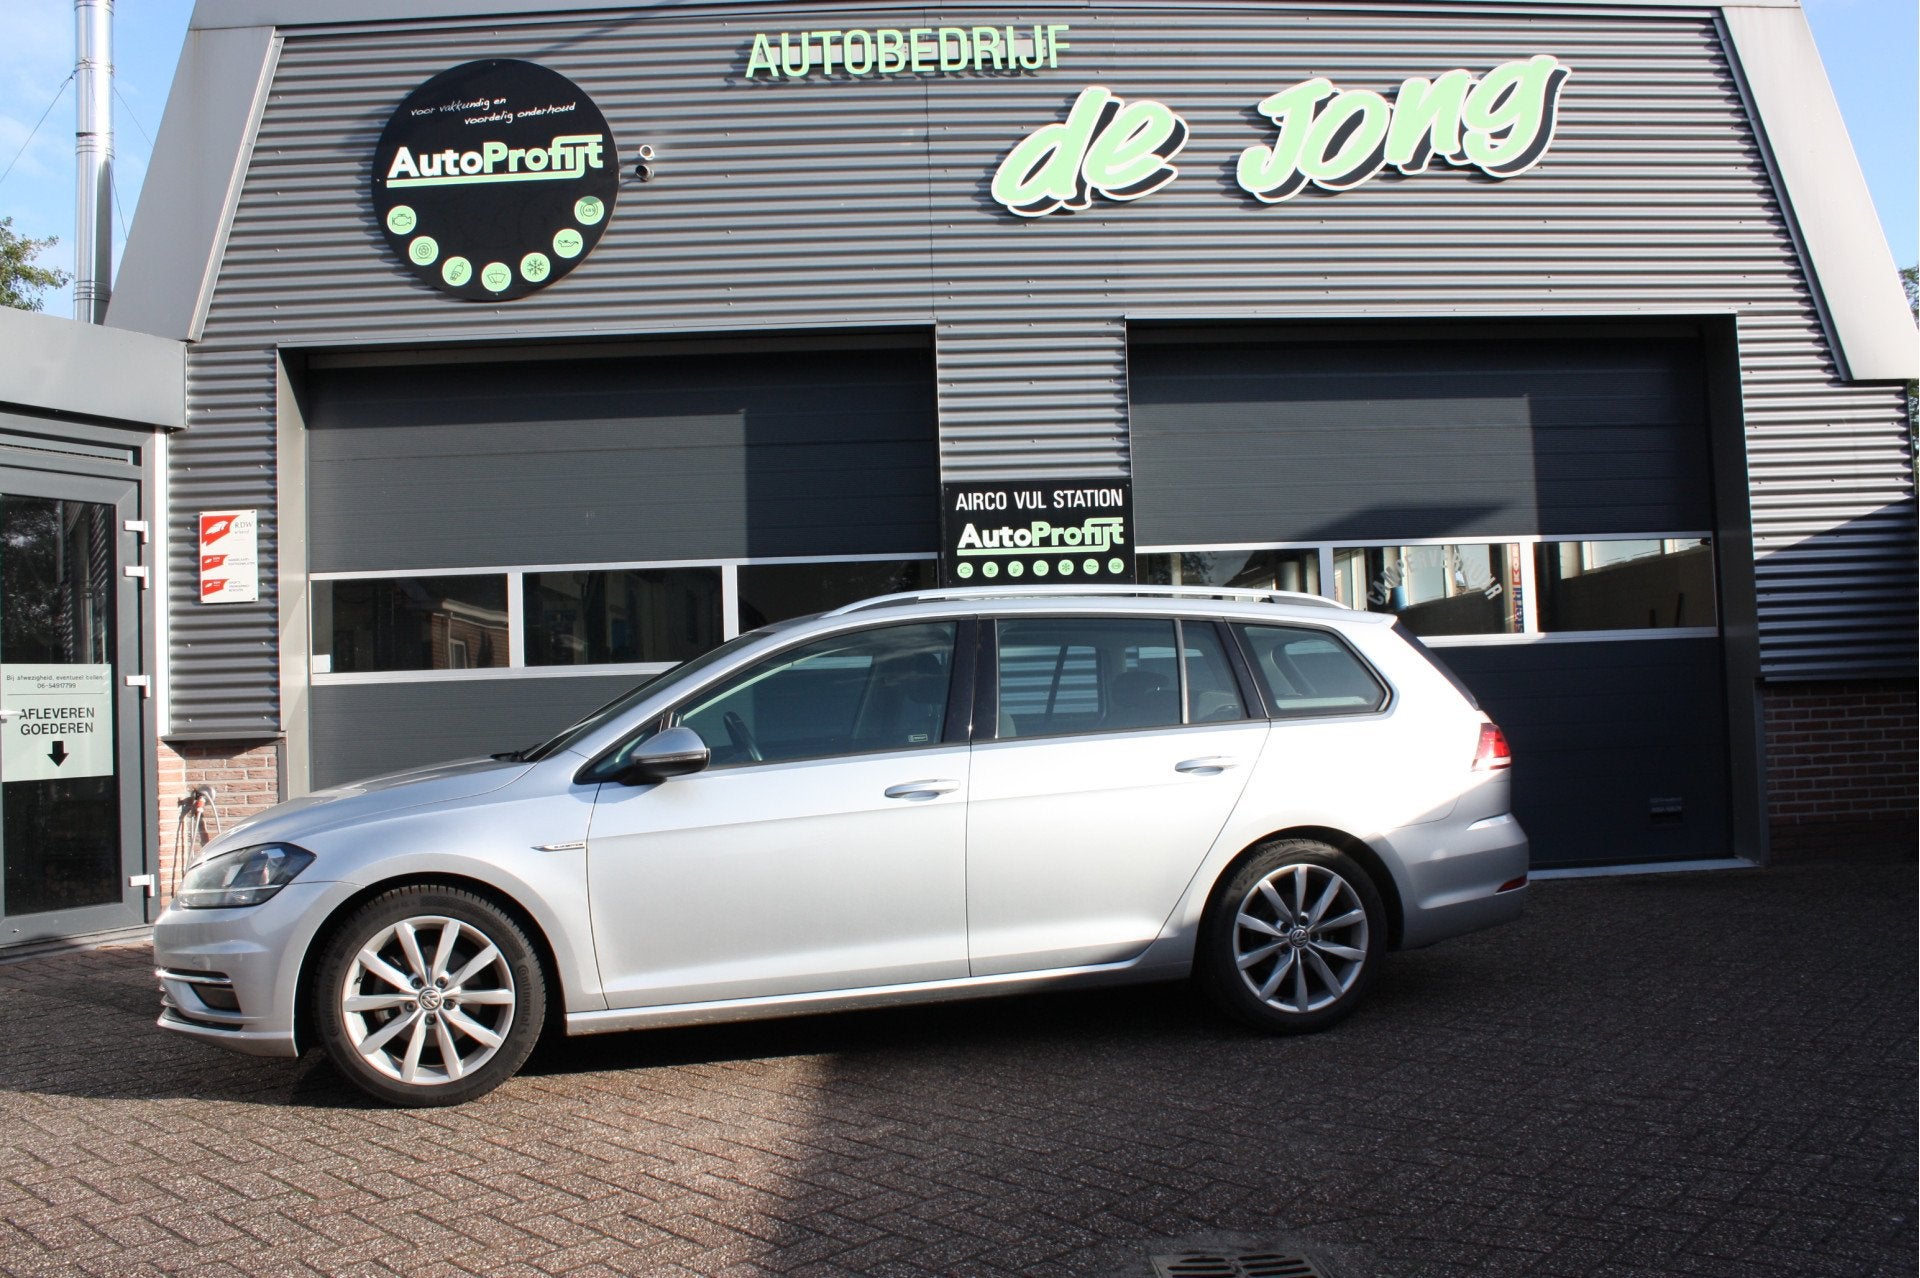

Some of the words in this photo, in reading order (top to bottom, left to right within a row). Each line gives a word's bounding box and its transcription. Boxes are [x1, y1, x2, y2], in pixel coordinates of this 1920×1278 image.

[745, 24, 1071, 79] AUTOBEDRIJF
[410, 107, 436, 117] voor
[439, 98, 490, 112] vakkundig
[493, 97, 507, 106] en
[464, 110, 514, 126] voordelig
[517, 102, 577, 119] onderhoud
[991, 86, 1190, 218] de
[1237, 54, 1573, 204] Jong
[386, 134, 604, 187] AutoProfijt
[955, 491, 1008, 511] AIRCO
[1014, 490, 1047, 510] VUL
[1053, 488, 1123, 509] STATION
[956, 517, 1125, 557] AutoProfijt
[6, 674, 15, 682] Bij
[19, 707, 95, 720] AFLEVEREN
[20, 722, 94, 736] GOEDEREN
